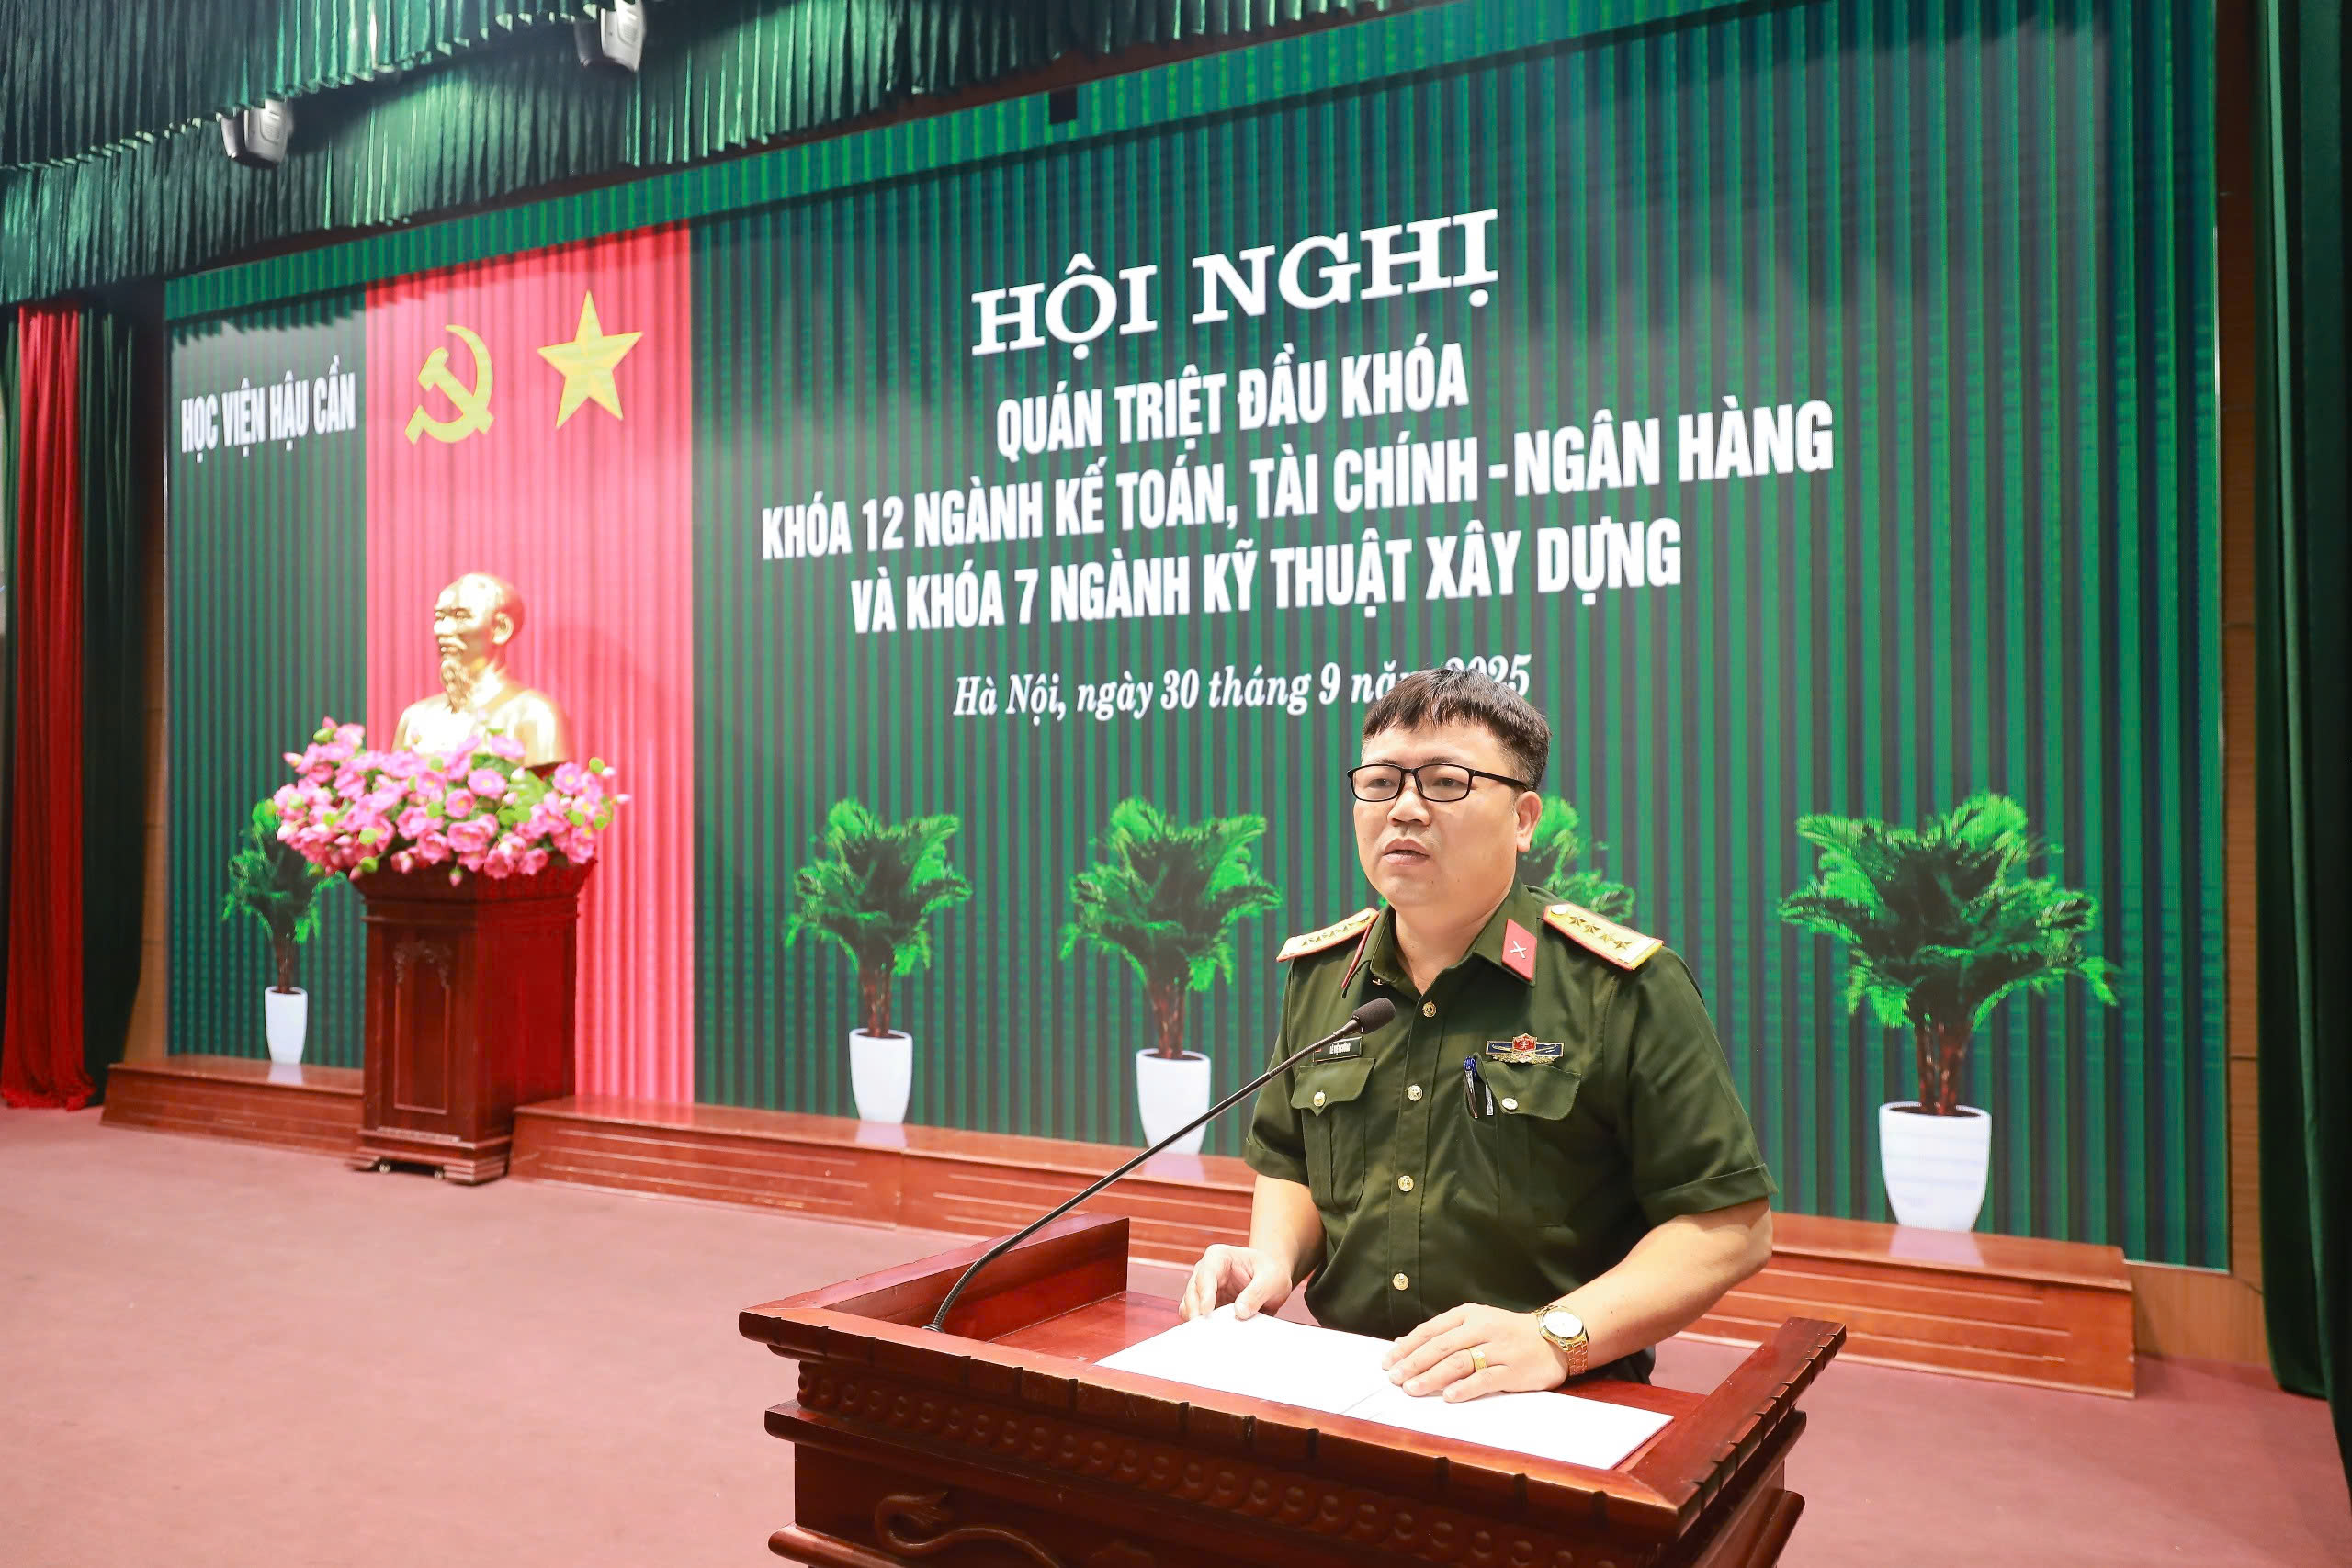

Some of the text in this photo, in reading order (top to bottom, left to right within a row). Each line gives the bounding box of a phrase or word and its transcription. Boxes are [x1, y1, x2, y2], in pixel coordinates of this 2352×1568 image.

[970, 208, 1499, 360] HỘI NGHỊ
[180, 393, 220, 464] HỌC
[220, 377, 266, 457] VIỆN
[268, 369, 311, 452] HẬU
[996, 332, 1470, 463] QUÁN TRIỆT ĐẦU KHÓA
[761, 491, 853, 560] KHÓA
[861, 495, 905, 552] 12
[913, 475, 1044, 548] NGÀNH
[1054, 455, 1107, 536] KẾ
[1115, 453, 1238, 531] TOÁN,
[1250, 442, 1319, 520] TÀI
[1333, 429, 1479, 513] CHÍNH
[1513, 408, 1661, 497] NGÂN
[1677, 394, 1835, 483] HÀNG
[850, 515, 1682, 634] VÀ KHÓA 7 NGÀNH KỸ THUẬT XÂY DỰNG
[952, 675, 997, 716] Hà
[1005, 672, 1067, 727] Nội,
[1076, 670, 1154, 722] ngày
[1159, 667, 1200, 710] 30
[1208, 664, 1313, 716] tháng
[1318, 661, 1342, 705] 9
[1350, 659, 1415, 704] nă
